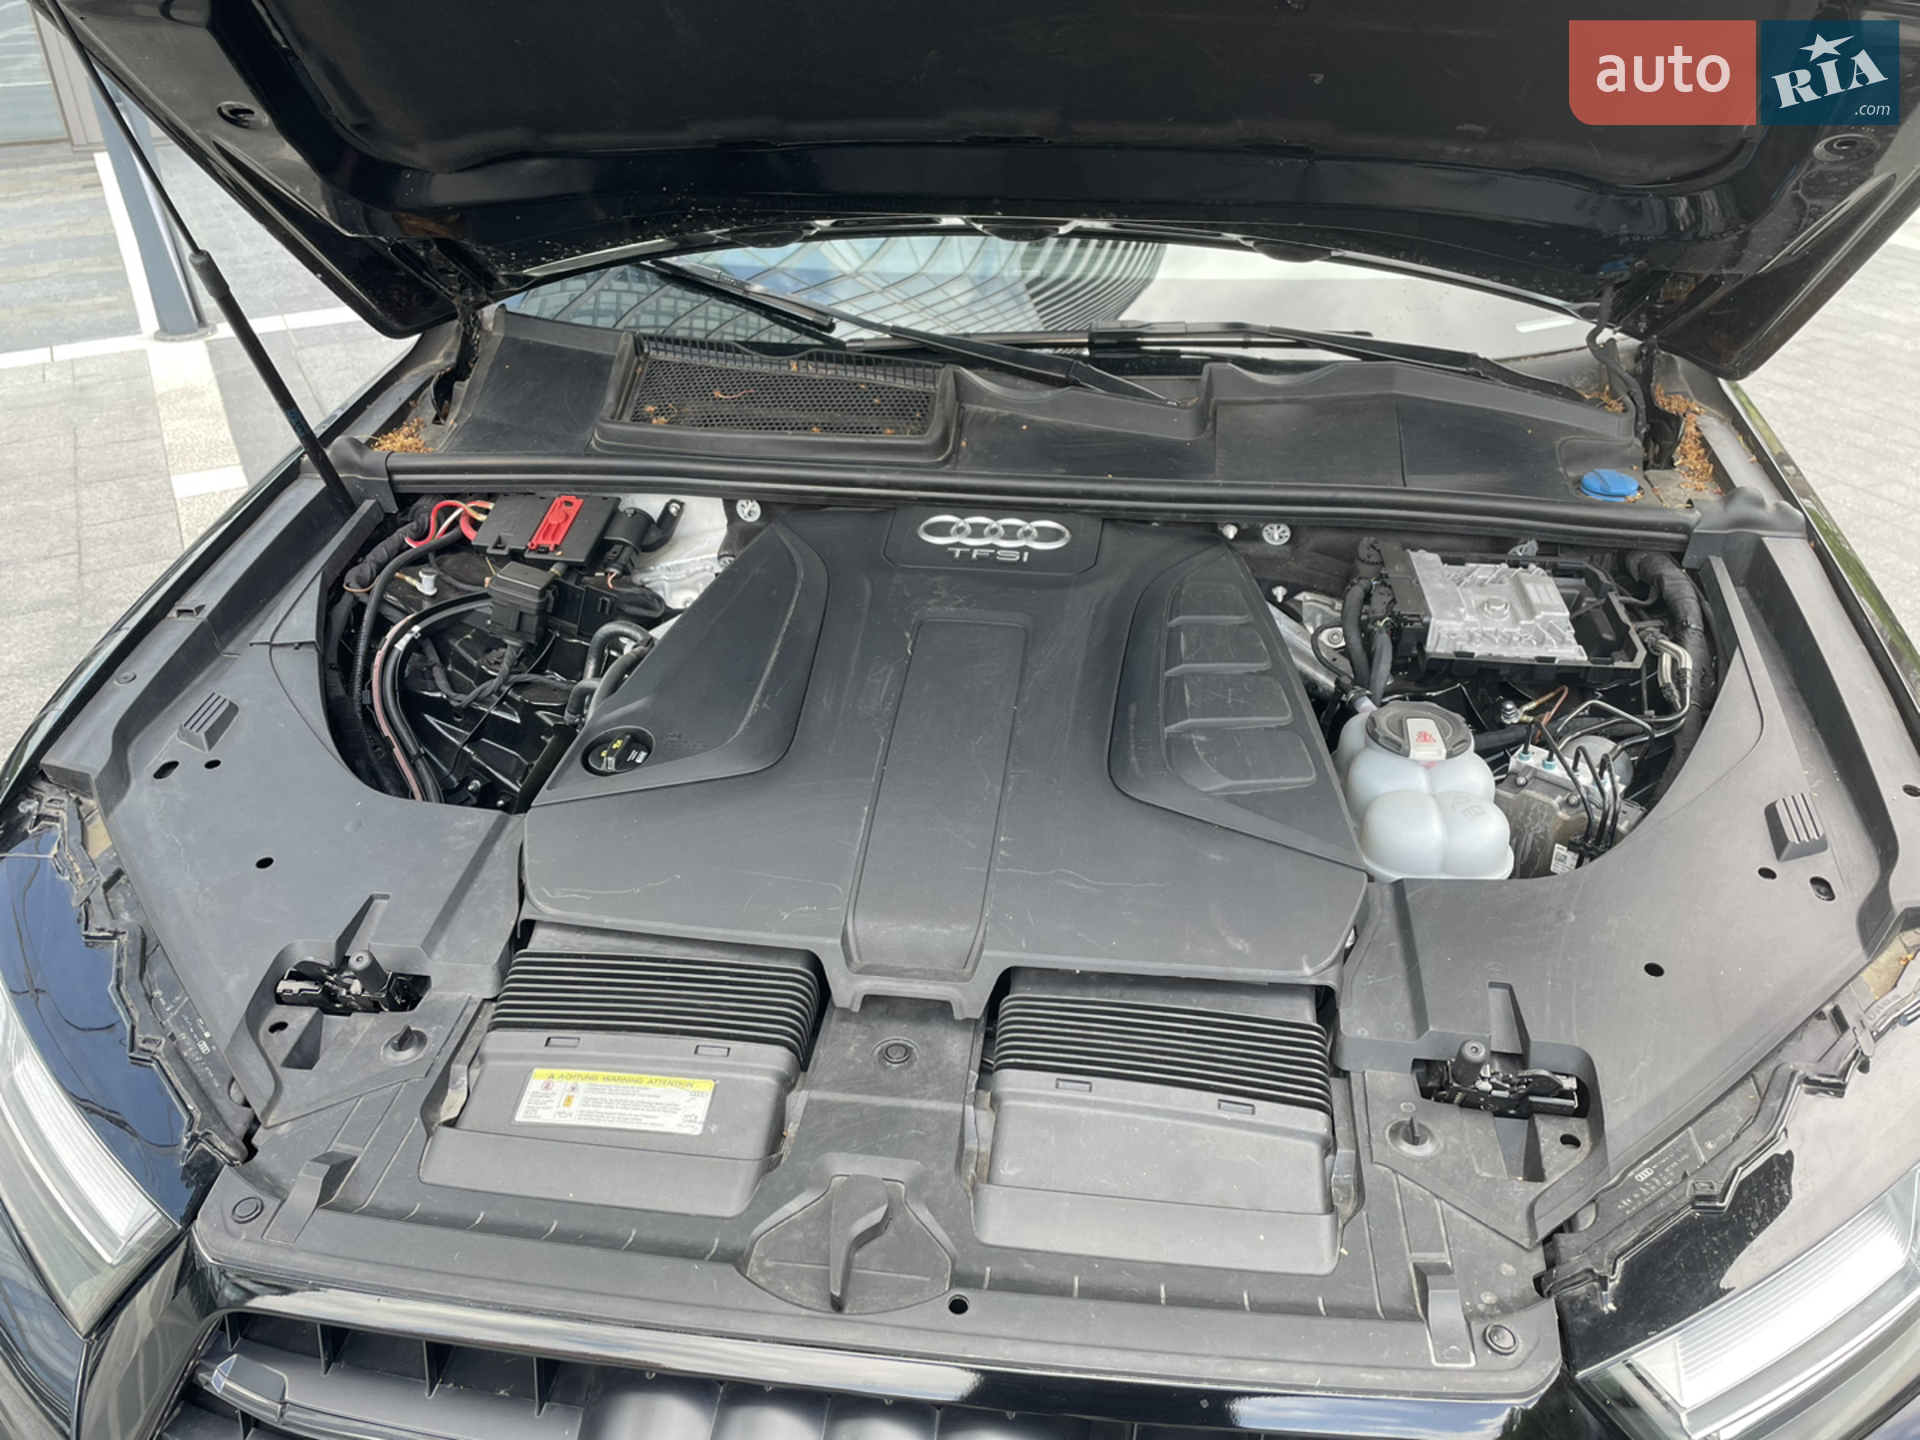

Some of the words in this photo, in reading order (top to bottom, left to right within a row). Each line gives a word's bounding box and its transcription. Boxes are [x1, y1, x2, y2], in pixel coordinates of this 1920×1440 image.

[947, 547, 1031, 563] TFSI
[602, 1075, 644, 1084] WARNING
[647, 1078, 694, 1088] ATTENTION
